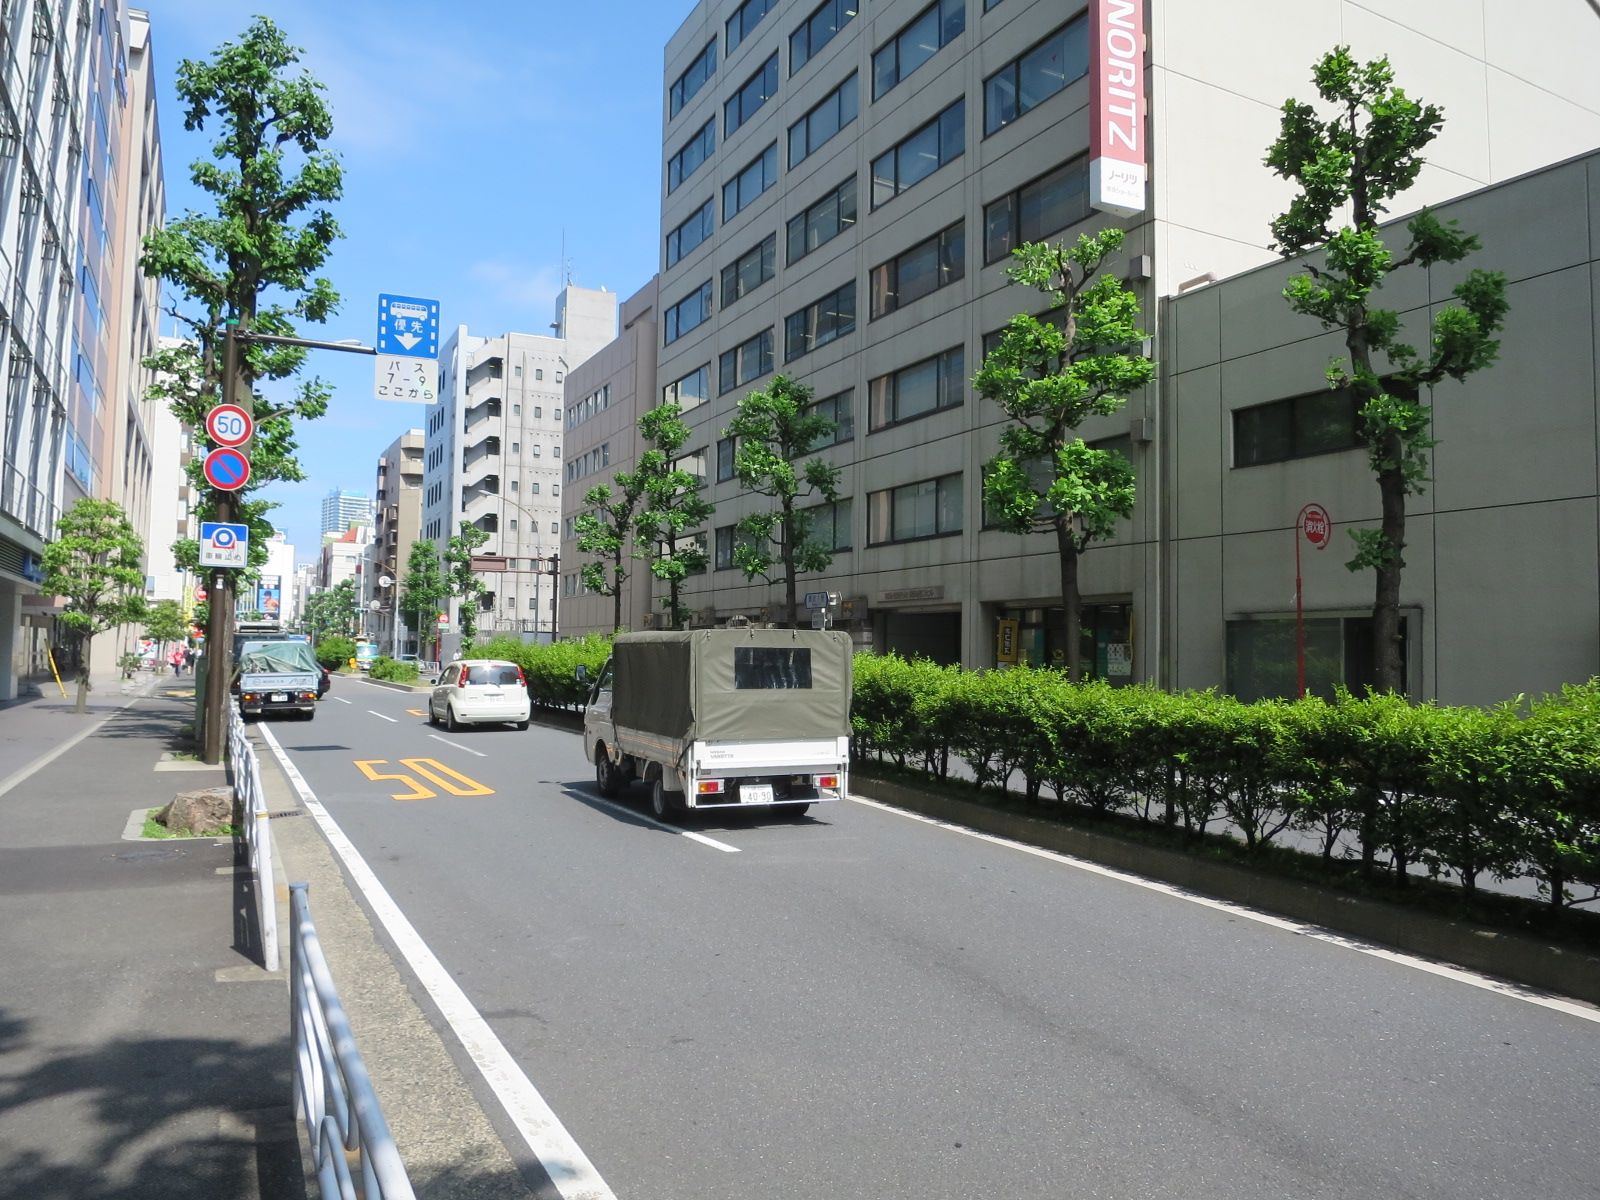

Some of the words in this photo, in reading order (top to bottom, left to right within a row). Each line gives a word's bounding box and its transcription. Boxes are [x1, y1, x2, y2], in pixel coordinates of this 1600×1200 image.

[1107, 0, 1137, 151] NORITZ
[394, 319, 424, 334] 優先
[389, 361, 425, 374] バス
[378, 385, 434, 400] ここから
[217, 416, 242, 436] 50
[1305, 519, 1325, 535] 消火栓
[352, 758, 497, 801] 50
